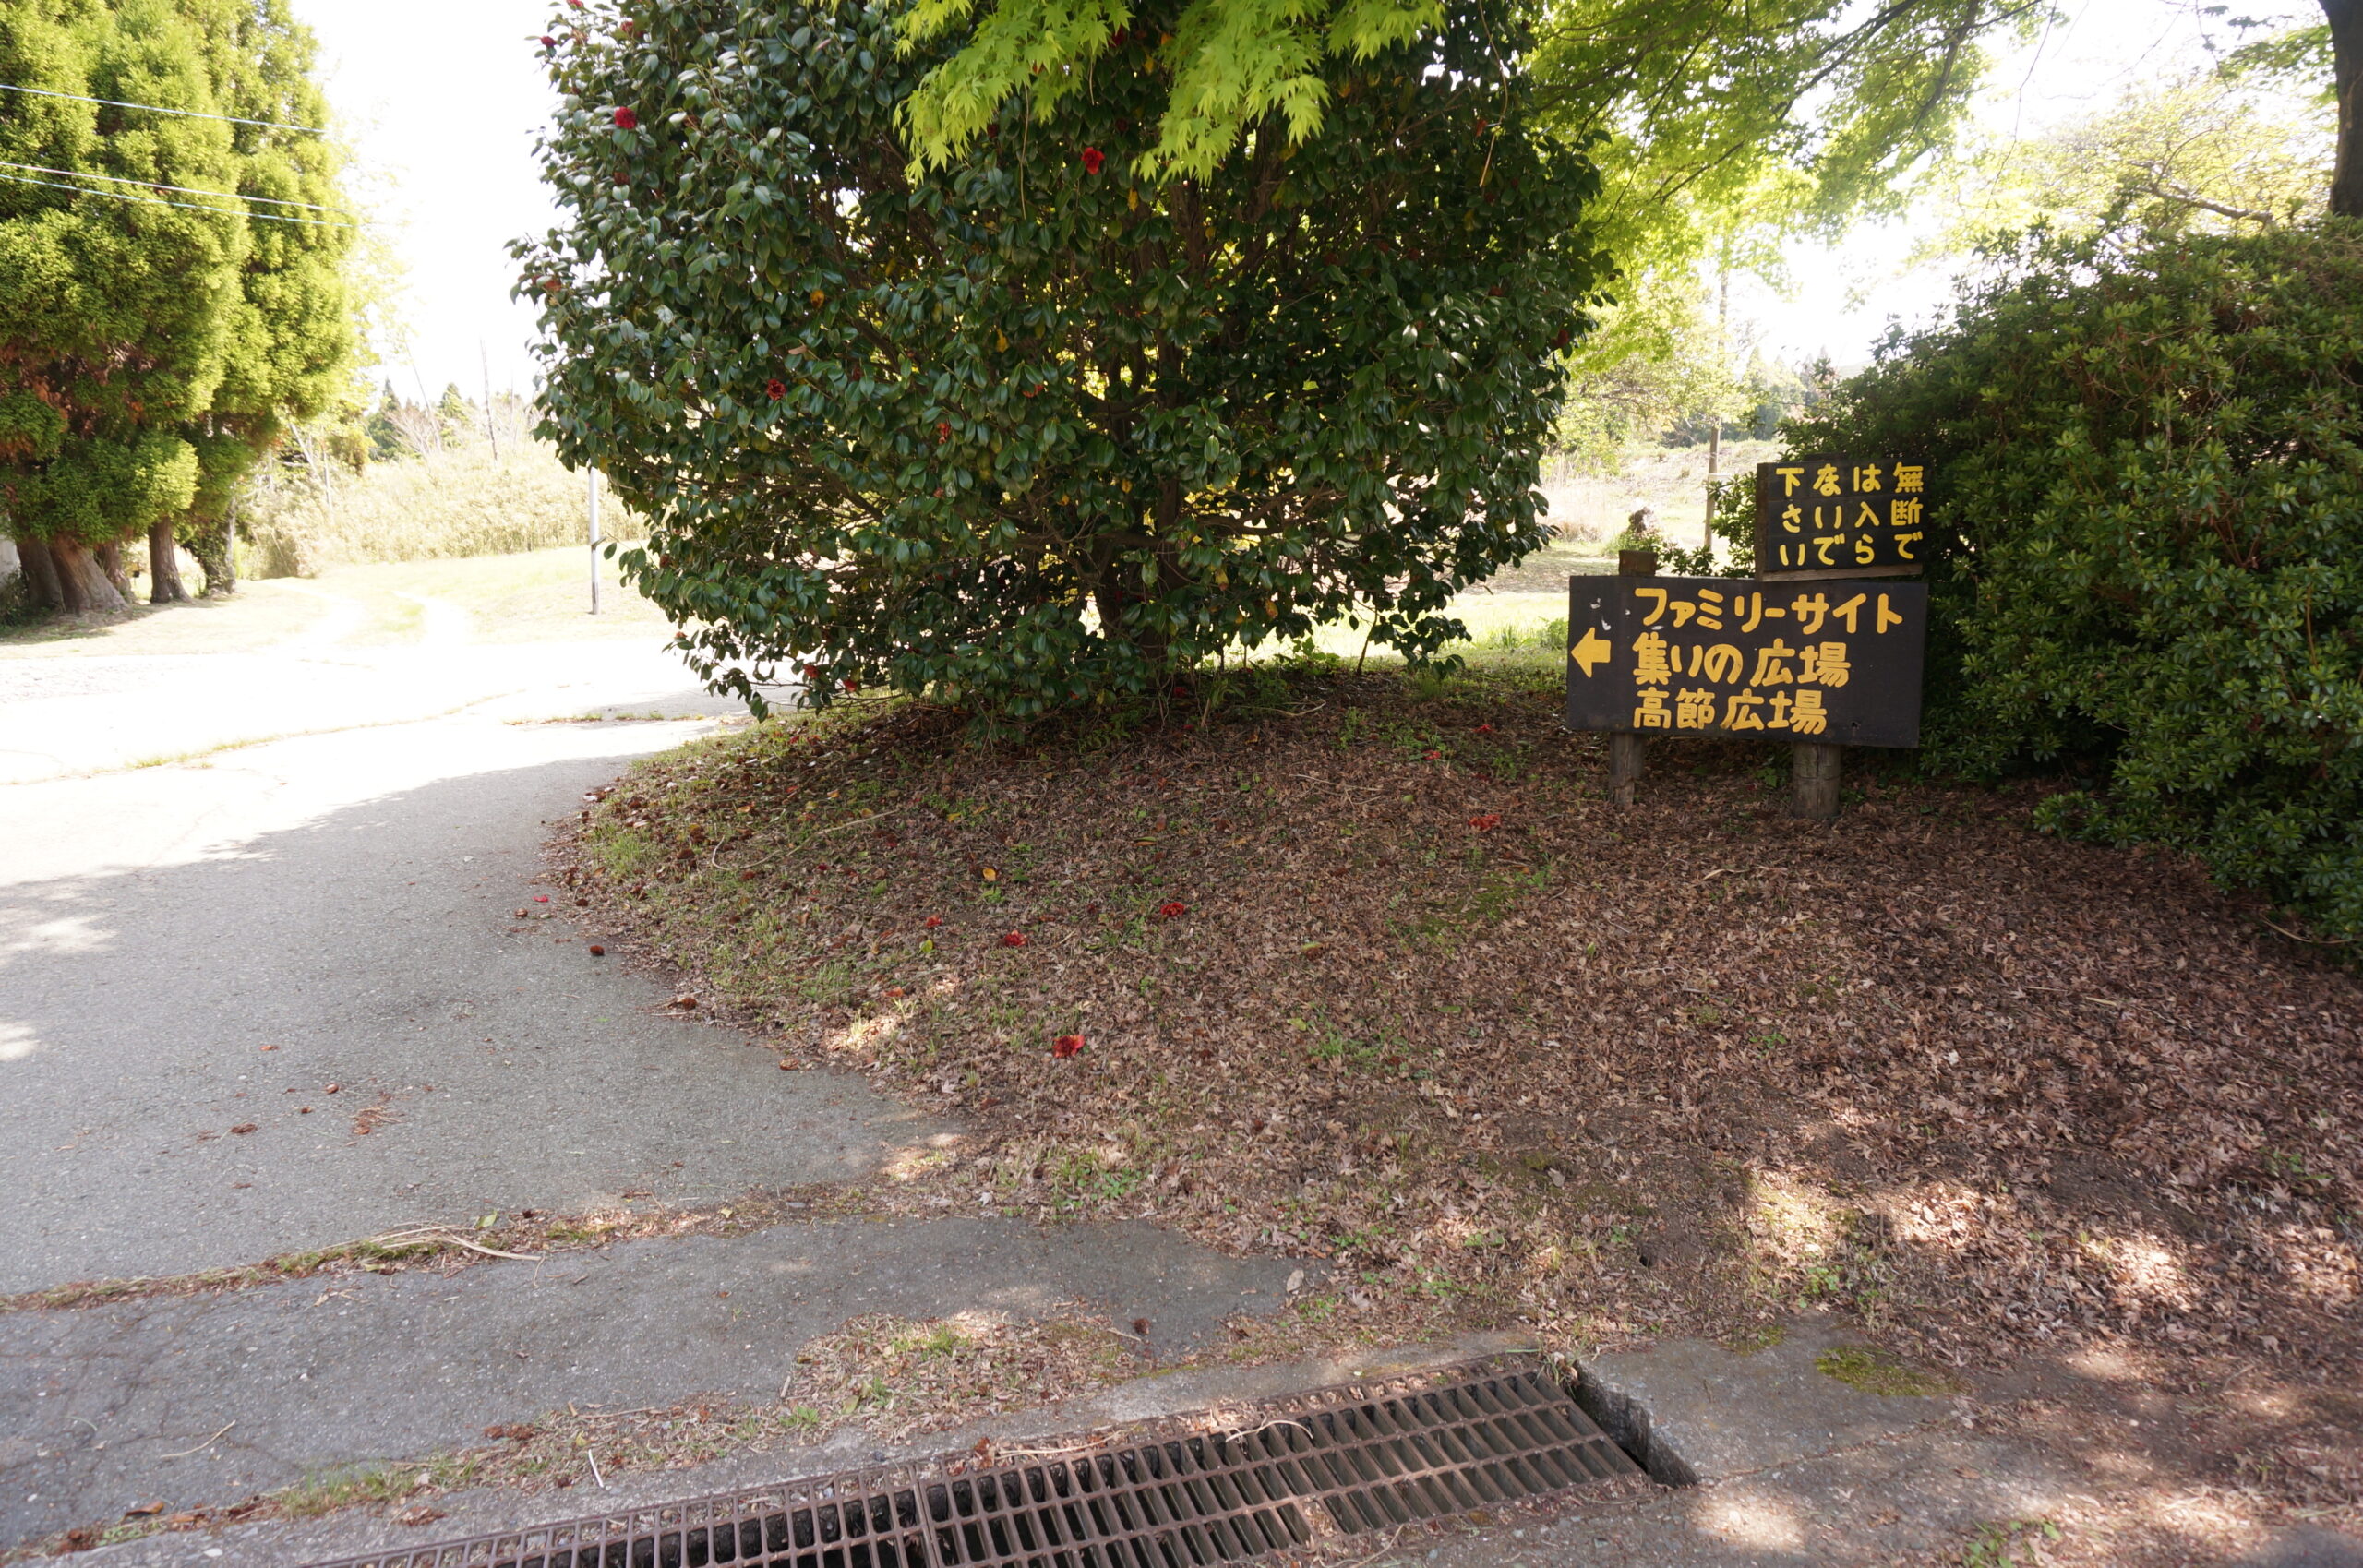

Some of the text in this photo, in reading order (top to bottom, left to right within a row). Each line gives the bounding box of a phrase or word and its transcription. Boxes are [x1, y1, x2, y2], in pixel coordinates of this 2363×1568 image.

[1776, 467, 1805, 567] 下さい
[1813, 463, 1845, 566] ないで
[1853, 463, 1882, 565] は入ら
[1890, 461, 1924, 559] 無断で
[1634, 588, 1903, 634] ファミリーサイト
[1633, 687, 1828, 735] 高節広場
